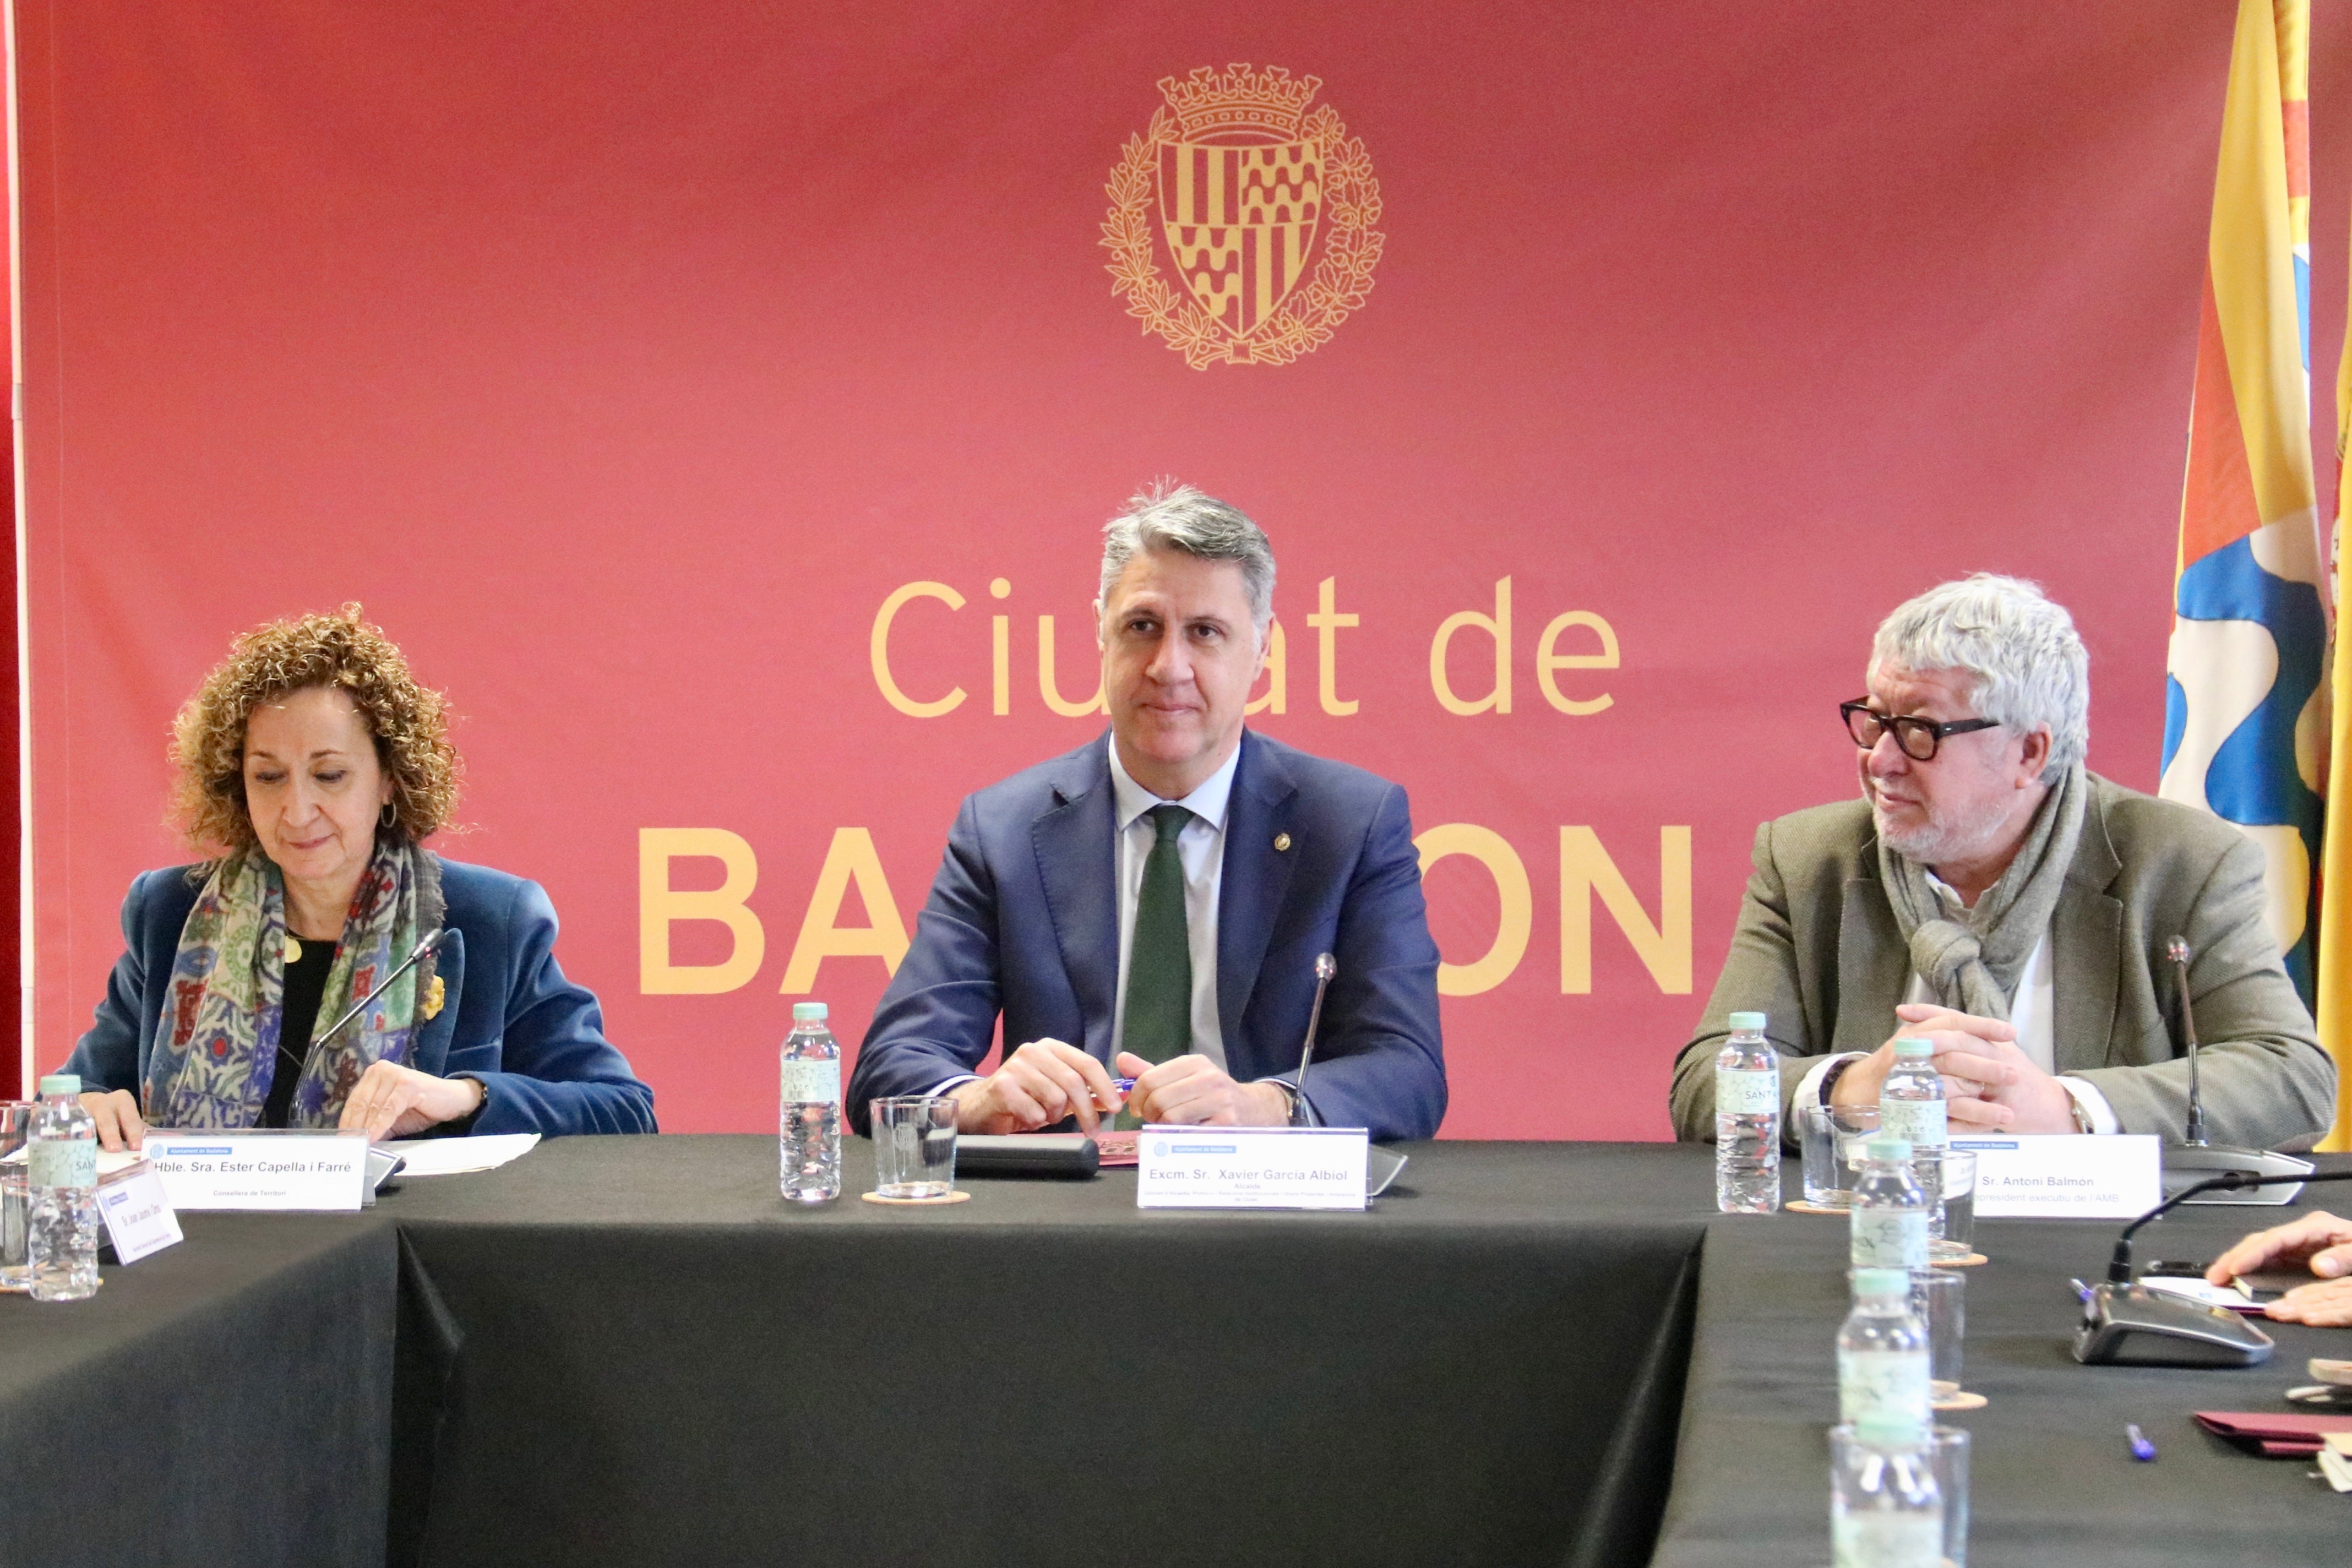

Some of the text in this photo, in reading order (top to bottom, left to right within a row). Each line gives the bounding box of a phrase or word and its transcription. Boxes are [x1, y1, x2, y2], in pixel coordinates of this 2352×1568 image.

[871, 574, 1620, 717] Ciuat de
[155, 1162, 351, 1174] Hble. Sra. Ester Capella i Farré
[1150, 1169, 1189, 1179] Excm.
[1193, 1169, 1210, 1179] Sr.
[1218, 1169, 1259, 1179] Xavier
[1309, 1170, 1347, 1180] Albiol
[1983, 1176, 1999, 1186] Sr.
[2003, 1176, 2043, 1186] Antoni
[2047, 1176, 2094, 1186] Balmón
[2029, 1194, 2071, 1202] executiu
[2074, 1194, 2087, 1202] de
